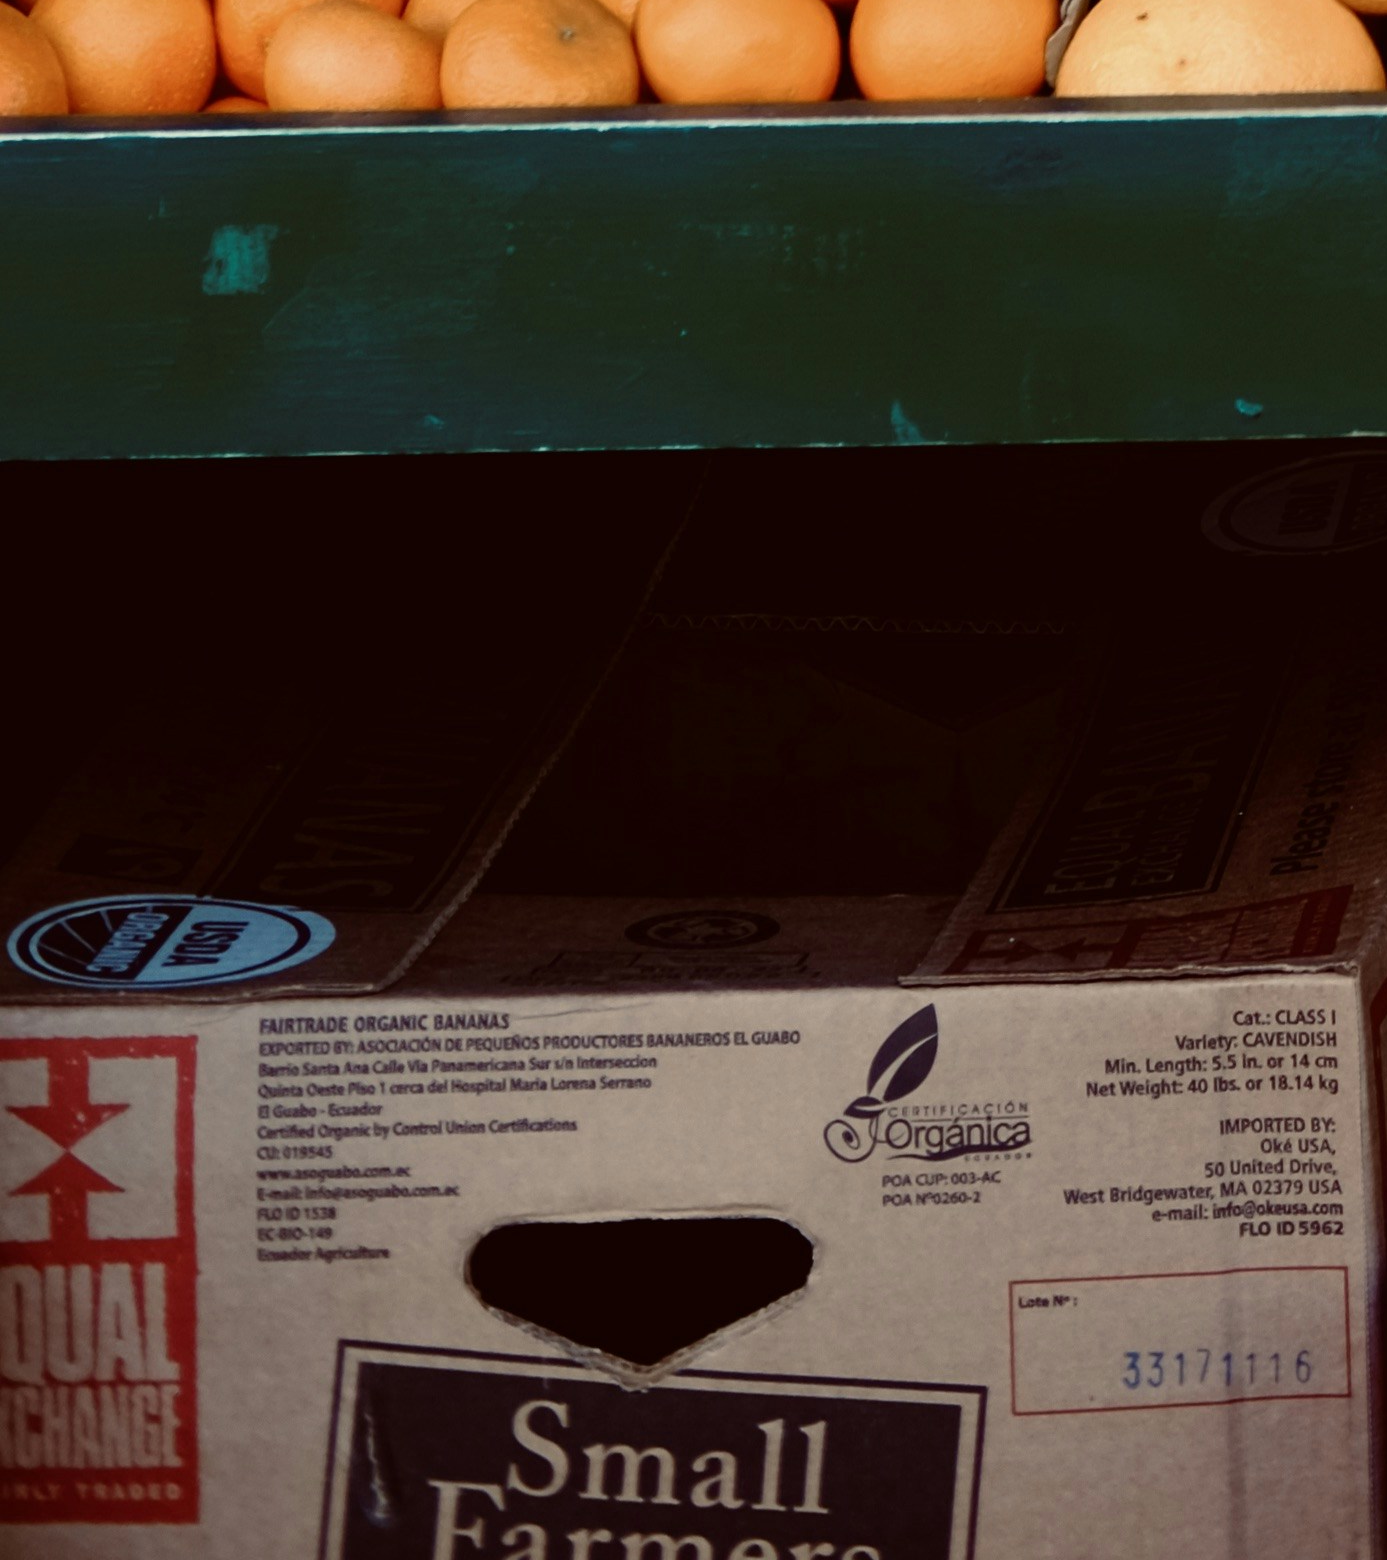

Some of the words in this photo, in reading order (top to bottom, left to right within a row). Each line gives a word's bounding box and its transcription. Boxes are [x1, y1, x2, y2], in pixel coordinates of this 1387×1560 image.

[162, 920, 250, 968] USDA
[259, 1016, 348, 1035] FAIRTRADE
[354, 1015, 428, 1033] ORGANIC
[434, 1013, 510, 1031] BANANAS
[1275, 1010, 1326, 1025] CLASS
[259, 1040, 330, 1057] EXPORTED
[445, 1038, 463, 1052] DE
[466, 1034, 540, 1051] PEQUEÑOS
[543, 1034, 644, 1050] PRODUCTORES
[647, 1032, 731, 1048] BANANEROS
[734, 1031, 748, 1046] EL
[751, 1031, 801, 1045] GUABO
[1175, 1035, 1238, 1052] Variety:
[1243, 1032, 1337, 1048] CAVENDISH
[303, 1062, 340, 1076] Santa
[432, 1057, 525, 1073] Panamericana
[530, 1058, 551, 1071] Sur
[1104, 1058, 1141, 1074] Min.
[1145, 1056, 1207, 1076] Length:
[1211, 1055, 1237, 1071] 5.5
[1242, 1054, 1262, 1069] in.
[1267, 1056, 1284, 1069] or
[1290, 1054, 1310, 1069] 14
[1314, 1056, 1338, 1069] cm
[427, 1080, 448, 1093] del
[450, 1078, 507, 1096] Hospital
[551, 1076, 597, 1090] Lorena
[600, 1076, 652, 1090] Serrano
[1086, 1082, 1116, 1097] Net
[1120, 1080, 1184, 1099] Weight:
[1187, 1079, 1209, 1094] 40
[1213, 1077, 1240, 1092] lbs.
[1245, 1079, 1263, 1092] or
[1270, 1076, 1314, 1091] 18.14
[1318, 1075, 1339, 1094] kg
[272, 1104, 317, 1118] Guabo
[328, 1103, 383, 1117] Ecuador
[318, 1123, 371, 1141] Organic
[373, 1123, 390, 1139] by
[393, 1121, 443, 1136] Control
[446, 1120, 485, 1134] Union
[488, 1117, 578, 1134] Certifications
[885, 1115, 1031, 1155] Orgánica
[1220, 1117, 1306, 1135] IMPORTED
[1310, 1117, 1336, 1133] BY:
[1260, 1138, 1293, 1154] Oké
[1298, 1138, 1336, 1156] USA,
[1204, 1161, 1225, 1178] 50
[1230, 1159, 1284, 1176] United
[1290, 1158, 1337, 1176] Drive,
[882, 1175, 912, 1188] POA
[951, 1171, 1002, 1185] 003-AC
[882, 1194, 912, 1207] POA
[1064, 1188, 1105, 1206] West
[1109, 1184, 1215, 1206] Bridgewater,
[1220, 1182, 1248, 1197] MA
[1252, 1180, 1304, 1196] 02379
[1308, 1179, 1342, 1195] USA
[1151, 1204, 1208, 1222] e-mail:
[1213, 1201, 1344, 1218] info@okeusa.com
[1239, 1222, 1271, 1238] FLO
[1276, 1222, 1295, 1236] ID
[1298, 1221, 1344, 1237] 5962
[1121, 1348, 1313, 1390] 33171116
[0, 1383, 183, 1469] CHANGE
[506, 1398, 830, 1515] Small
